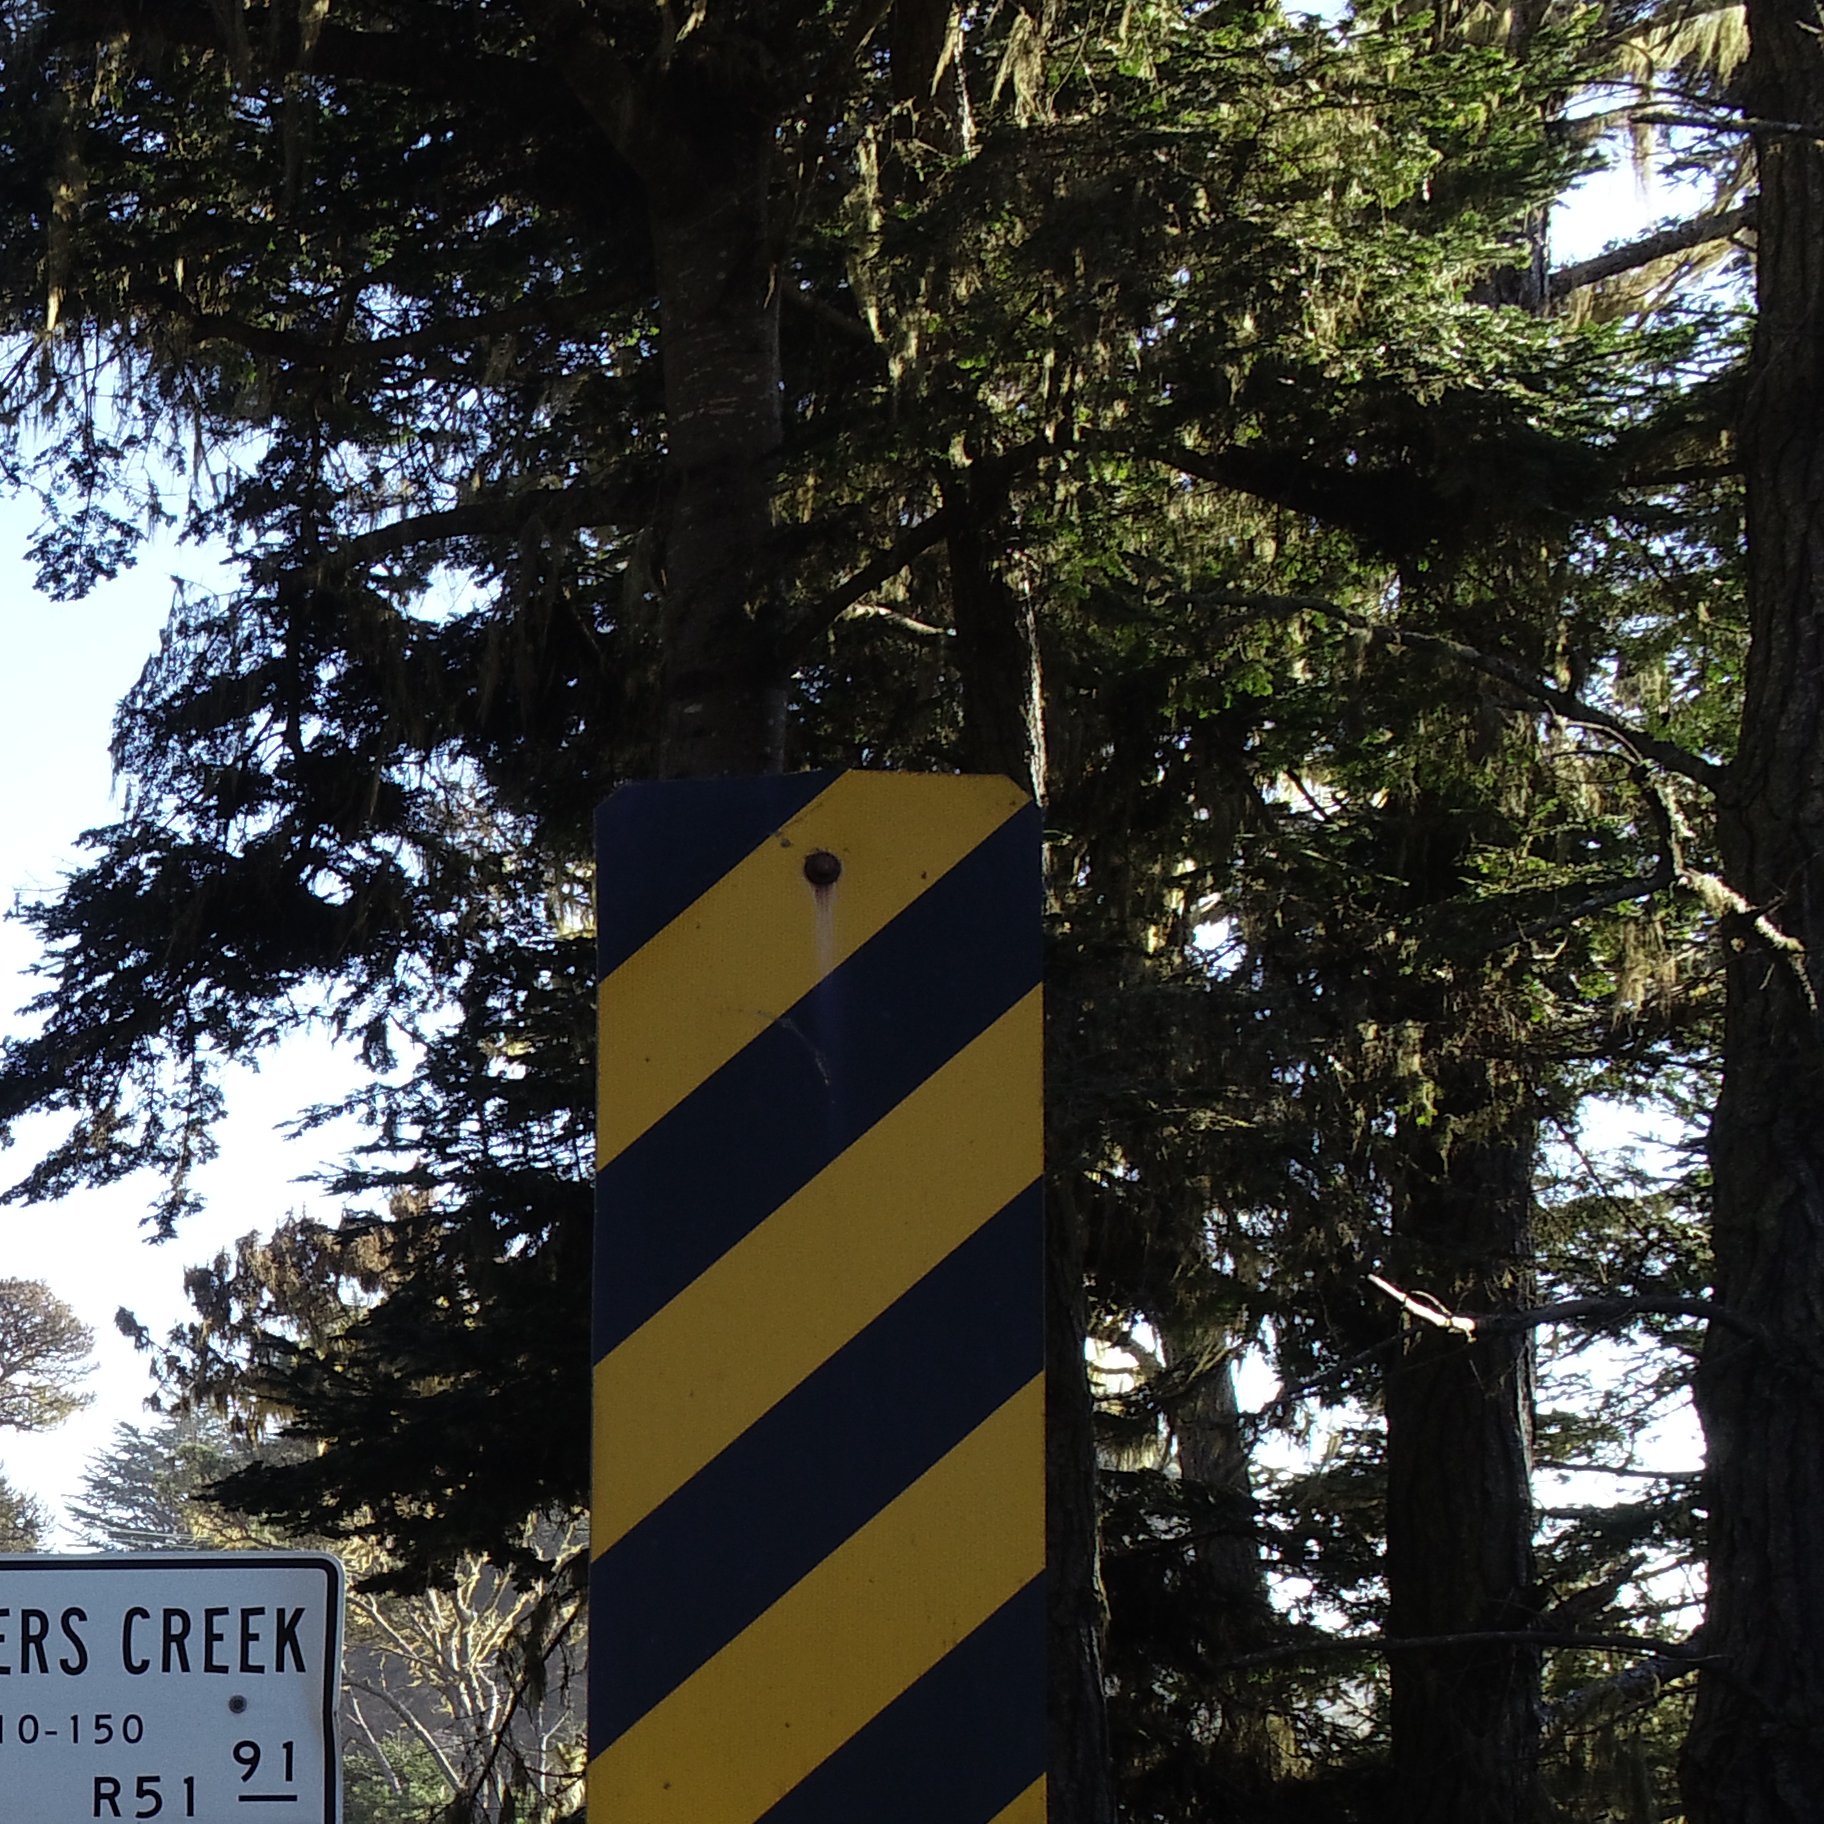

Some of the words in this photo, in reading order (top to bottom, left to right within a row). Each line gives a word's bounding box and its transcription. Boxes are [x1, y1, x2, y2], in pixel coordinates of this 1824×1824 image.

[121, 1606, 307, 1675] CREEK
[92, 1775, 195, 1820] R51
[232, 1740, 295, 1783] 91
